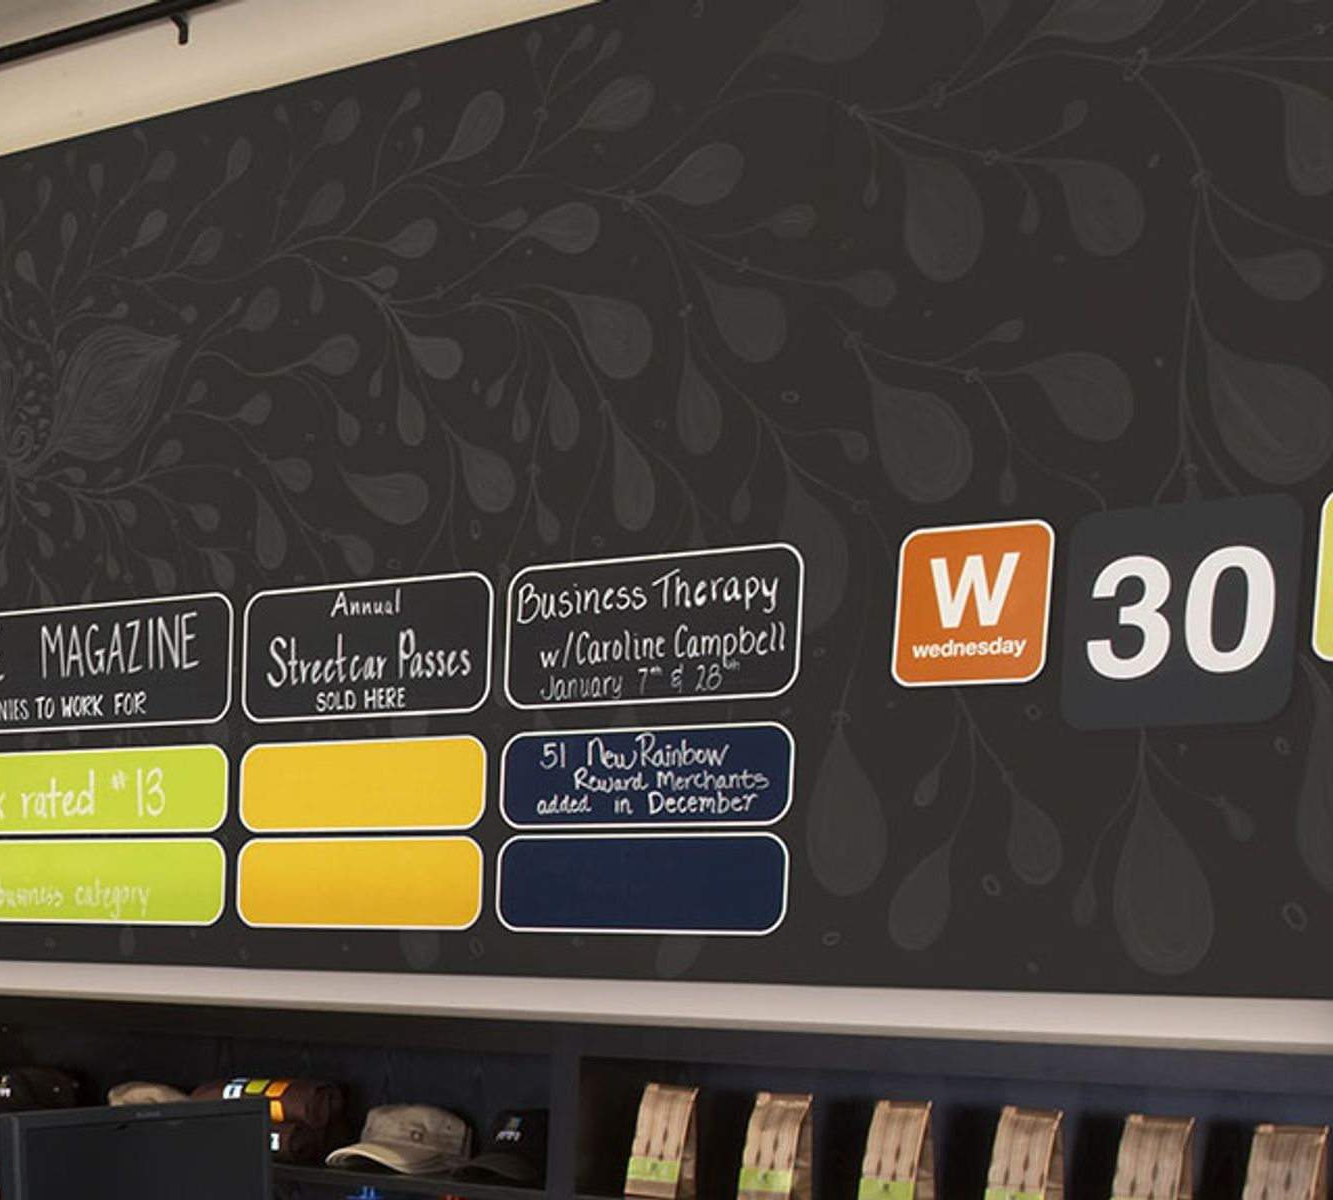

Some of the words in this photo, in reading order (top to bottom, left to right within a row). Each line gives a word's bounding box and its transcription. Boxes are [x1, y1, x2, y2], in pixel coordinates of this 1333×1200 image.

[330, 587, 402, 618] Annual
[516, 581, 648, 625] Business
[651, 567, 779, 614] Therapy
[930, 551, 1021, 631] W
[1086, 544, 1276, 681] 30
[39, 610, 200, 679] MAGAZINE
[266, 632, 387, 688] Streetcar
[398, 627, 472, 680] Passes
[539, 629, 666, 669] w/Caroline
[674, 620, 787, 669] Campbell
[912, 635, 1027, 660] wednesday
[35, 696, 55, 720] TO
[61, 692, 104, 718] WORK
[114, 690, 148, 716] FOR
[315, 690, 357, 713] SOLD
[364, 687, 407, 710] HERE
[539, 674, 624, 701] January
[538, 741, 566, 770] 51
[586, 736, 638, 770] New
[635, 731, 731, 769] Rainbow
[20, 768, 96, 819] rated
[572, 766, 649, 794] Reward
[656, 768, 771, 790] Merchants
[536, 794, 593, 815] added
[614, 795, 634, 815] in
[648, 790, 759, 815] December
[73, 878, 151, 920] category
